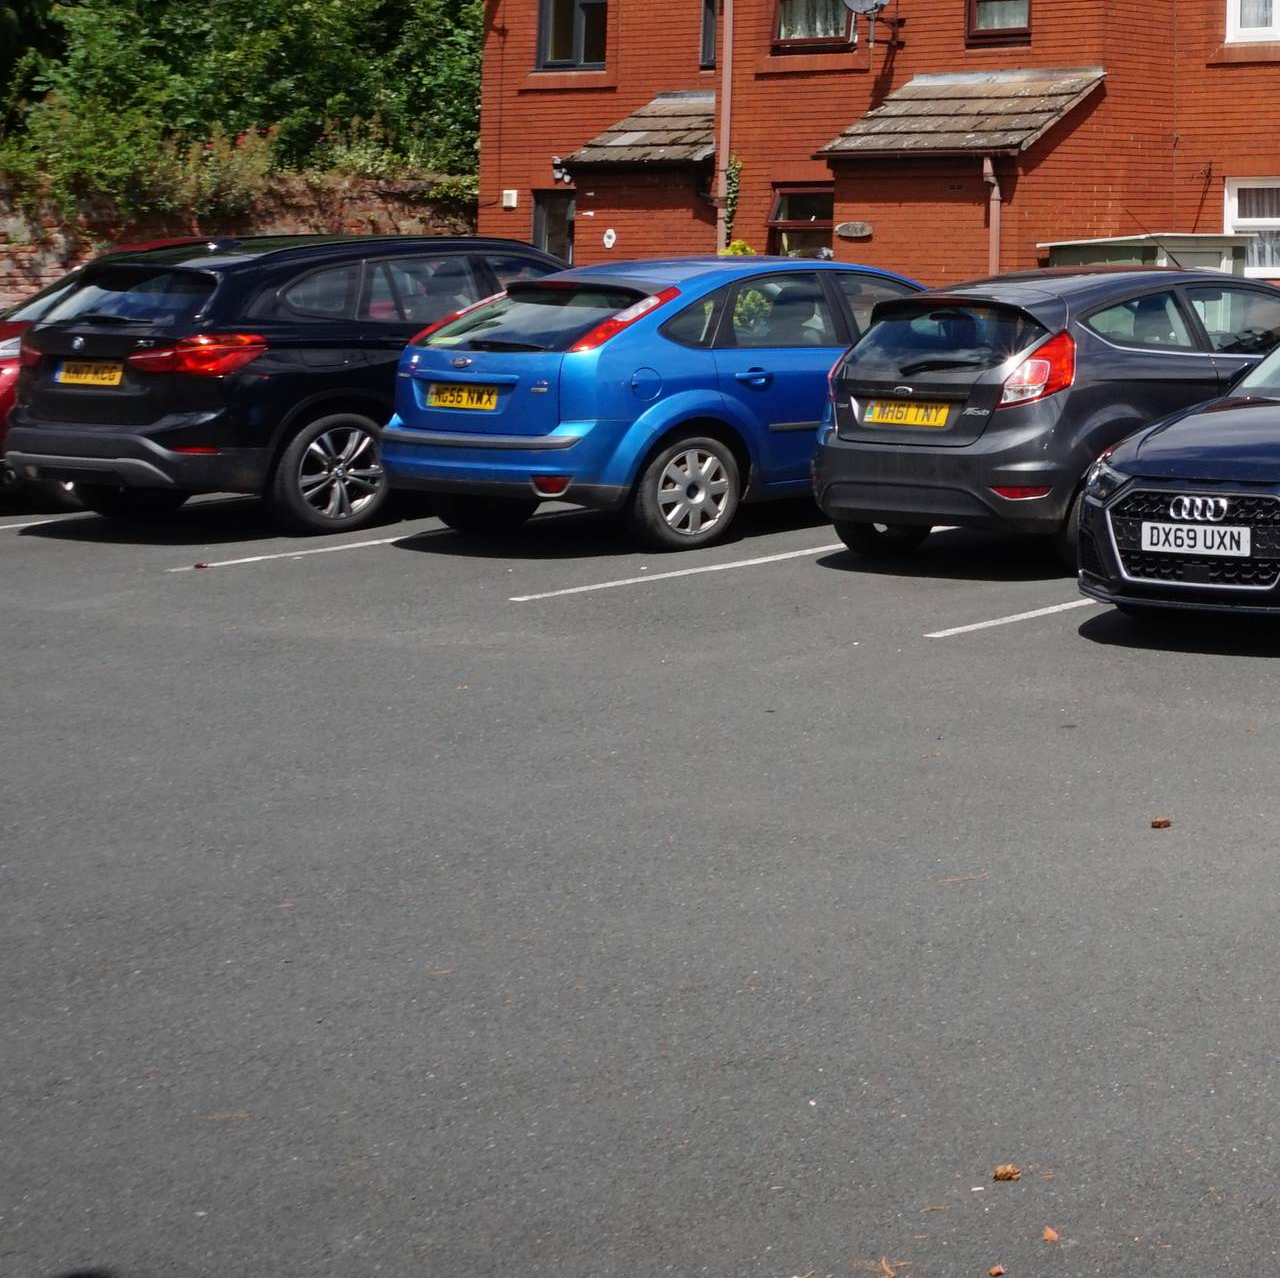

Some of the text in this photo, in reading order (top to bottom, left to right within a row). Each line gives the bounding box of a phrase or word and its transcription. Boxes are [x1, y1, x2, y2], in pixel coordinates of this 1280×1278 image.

[434, 385, 496, 405] NG56 NWX
[913, 403, 945, 423] TNY
[1150, 526, 1241, 551] DX69 UXN
